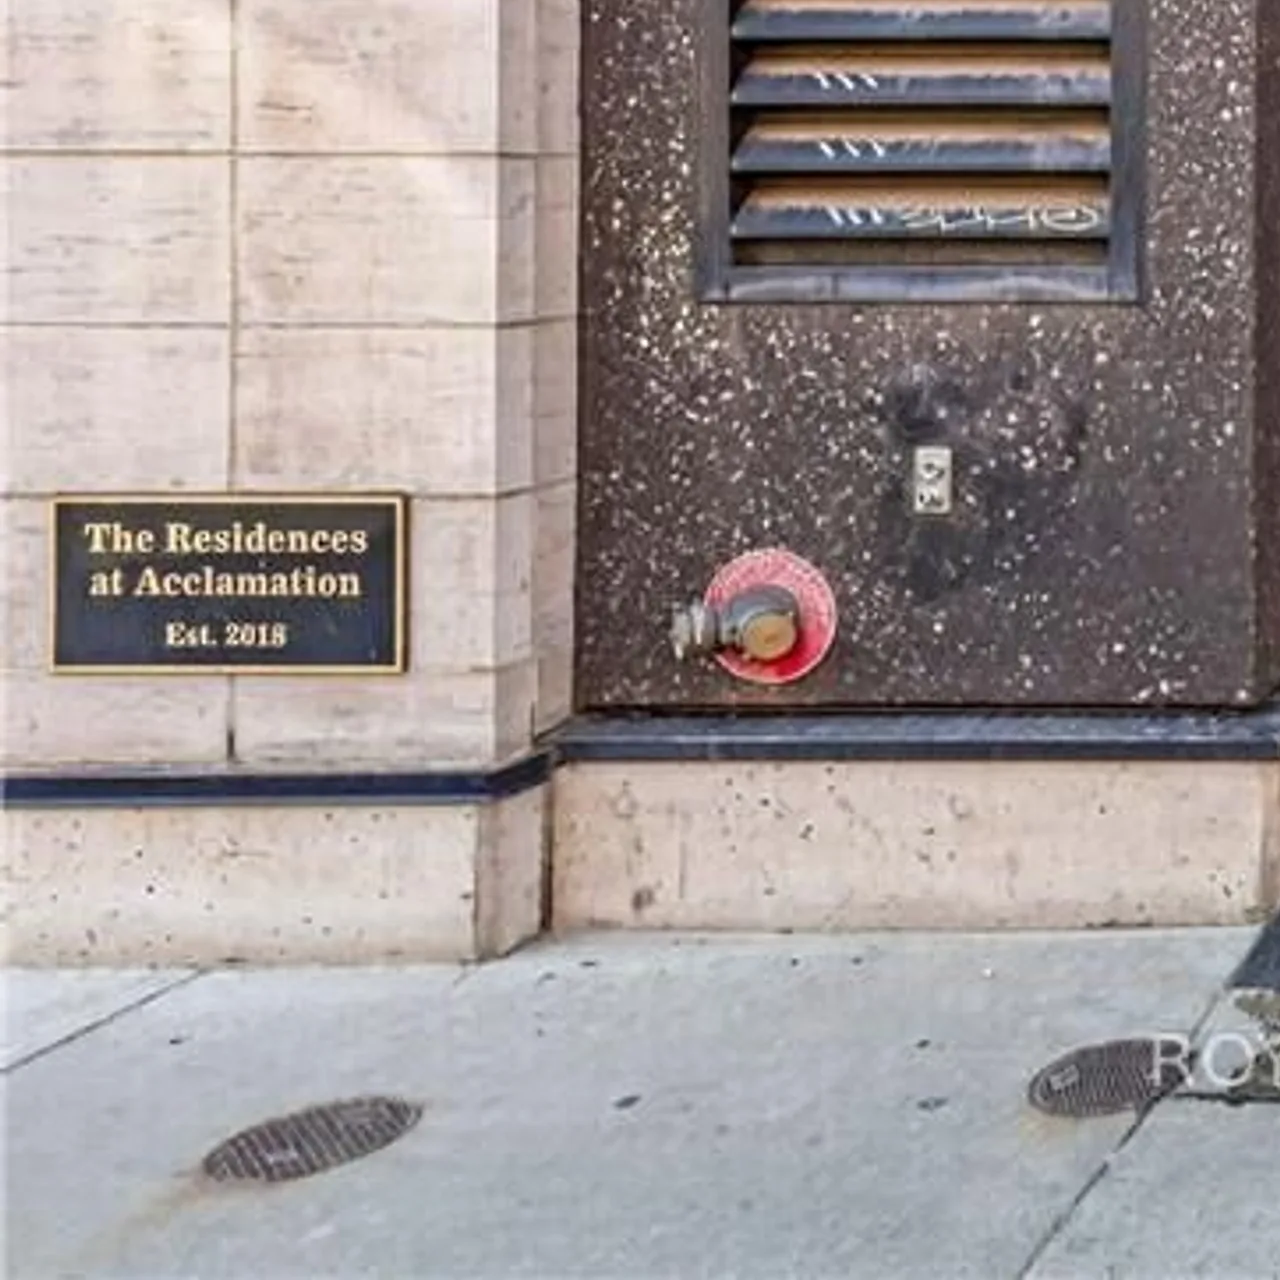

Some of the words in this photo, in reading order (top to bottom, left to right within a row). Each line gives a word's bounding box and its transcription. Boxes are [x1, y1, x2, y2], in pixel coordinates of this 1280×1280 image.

[84, 522, 155, 554] The
[165, 522, 369, 554] Residences
[90, 568, 124, 597] at
[133, 566, 362, 597] Acclamation
[164, 622, 217, 648] Est.
[224, 622, 289, 648] 2018
